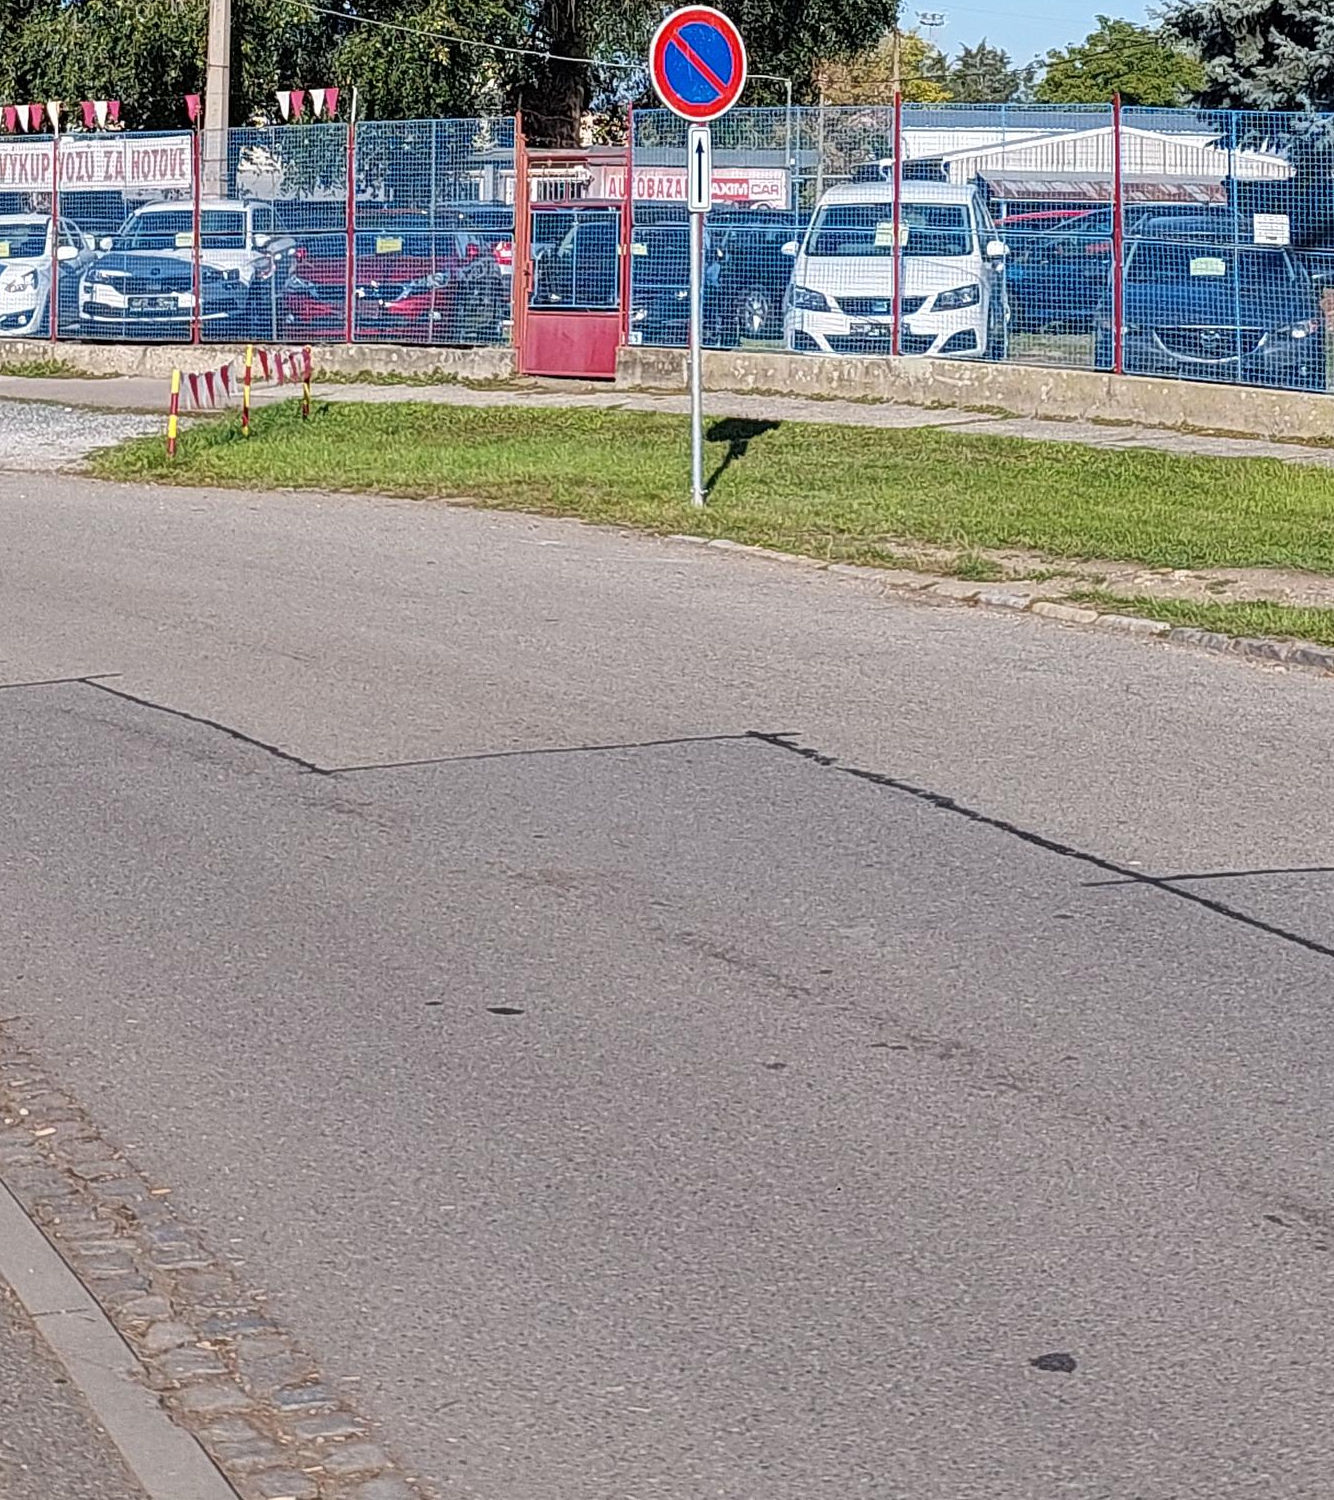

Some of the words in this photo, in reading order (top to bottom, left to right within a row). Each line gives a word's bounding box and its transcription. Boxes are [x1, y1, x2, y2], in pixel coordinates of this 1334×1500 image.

[608, 177, 688, 198] AUOBAZA
[712, 183, 748, 196] AXIM
[751, 184, 779, 196] CAR
